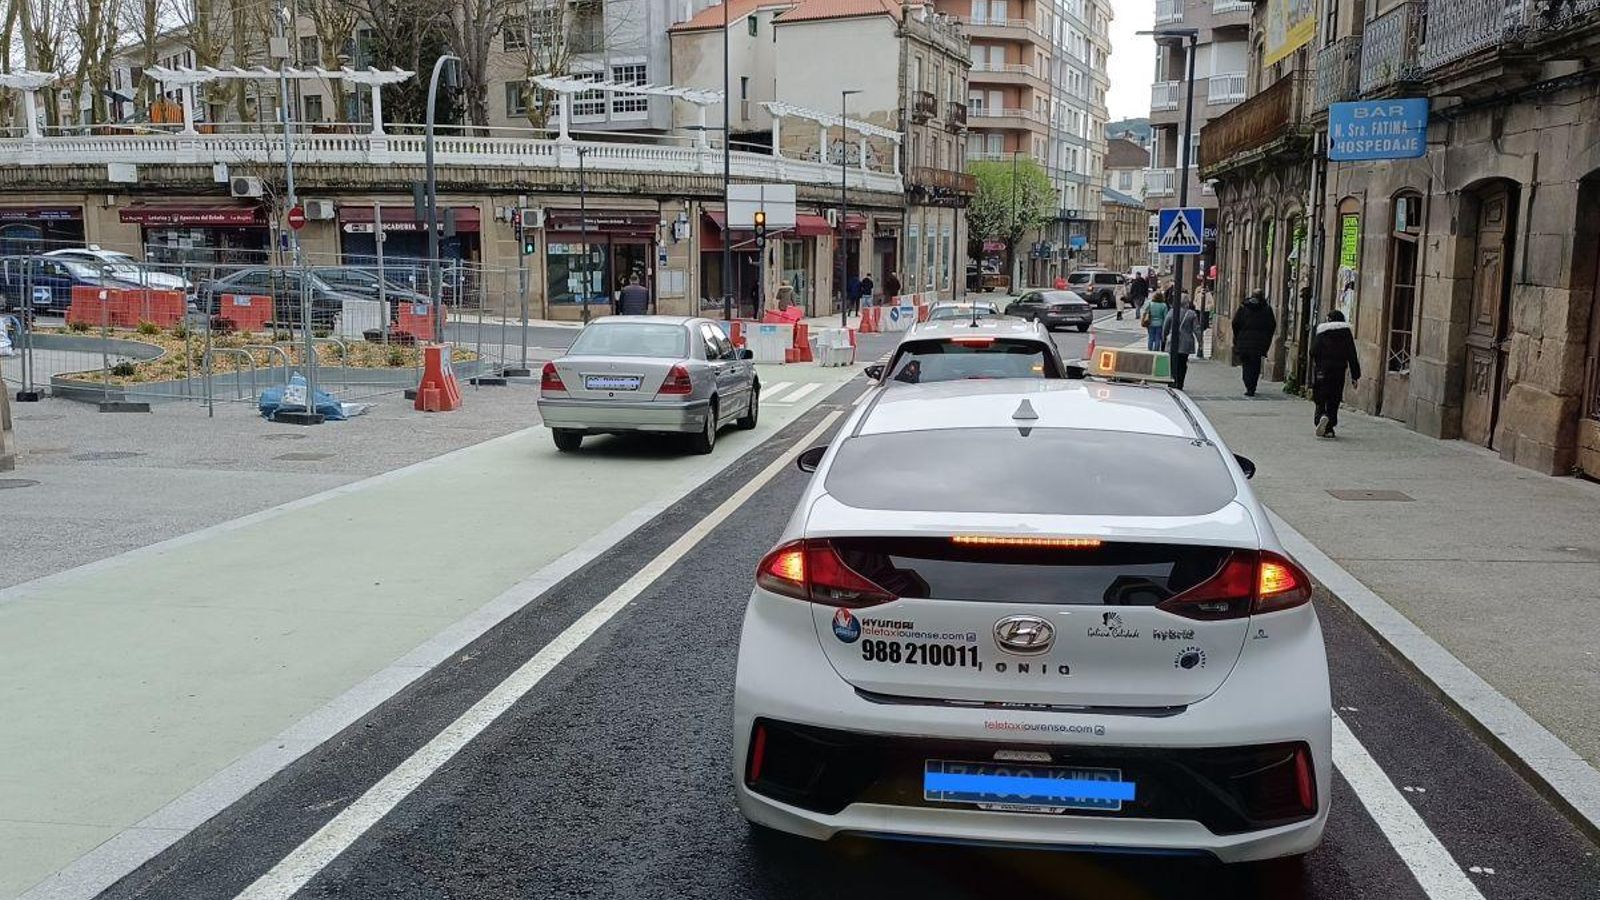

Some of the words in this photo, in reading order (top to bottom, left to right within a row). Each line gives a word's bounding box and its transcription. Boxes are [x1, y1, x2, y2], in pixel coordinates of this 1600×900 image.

[1354, 106, 1404, 118] BAR
[1371, 121, 1408, 135] FATIMA
[1338, 138, 1418, 153] HOSPEDAJE
[862, 626, 965, 642] teletaxiourense.com
[862, 638, 901, 663] 988
[905, 642, 978, 668] 210011
[984, 720, 1093, 734] teletaxiourense.com
